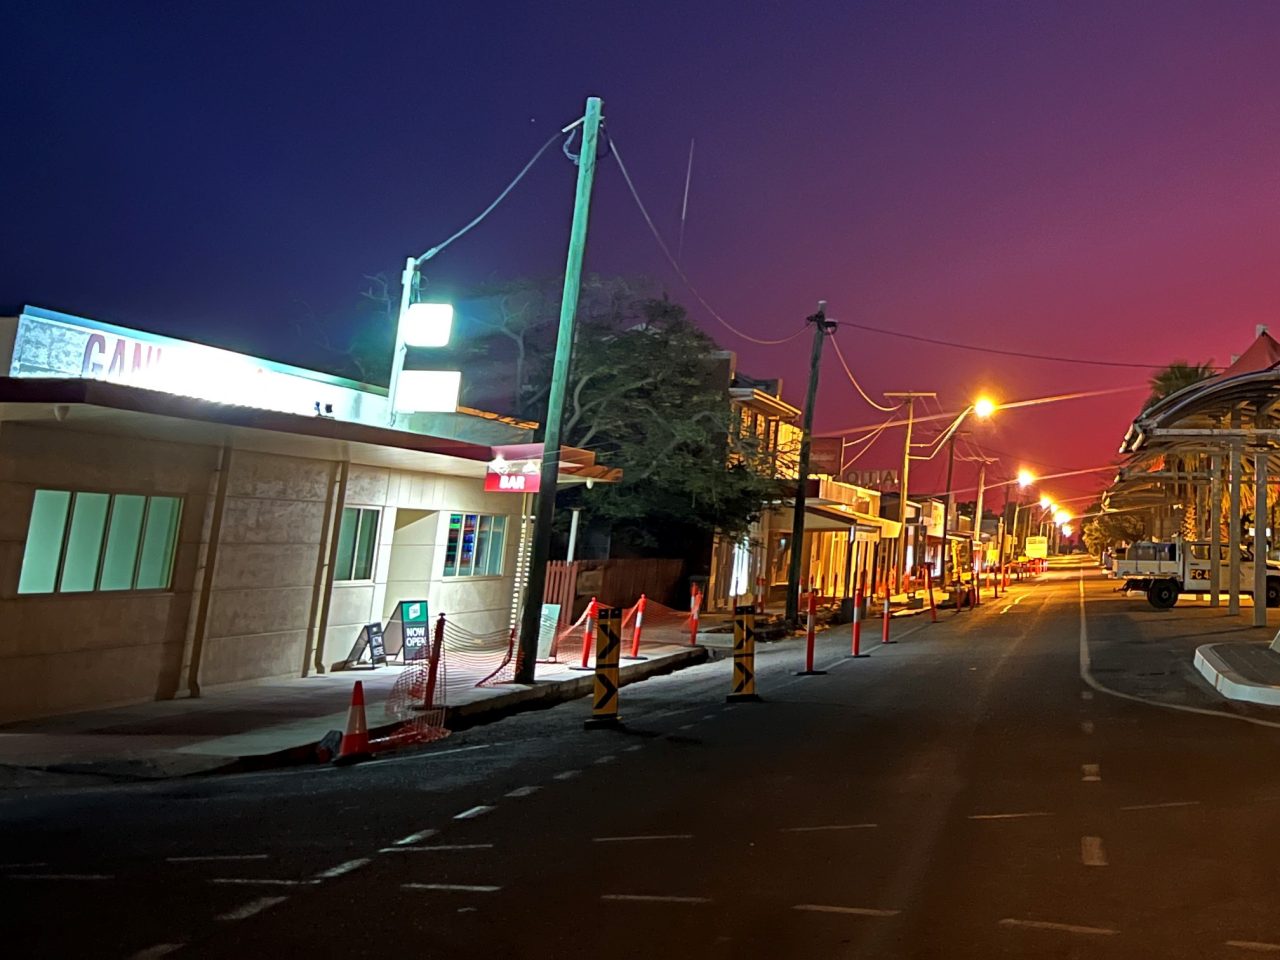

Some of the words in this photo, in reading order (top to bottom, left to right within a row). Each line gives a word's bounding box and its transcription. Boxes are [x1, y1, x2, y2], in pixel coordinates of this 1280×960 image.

[499, 475, 525, 490] BAR
[406, 627, 425, 636] NOW
[406, 637, 427, 646] OPEN
